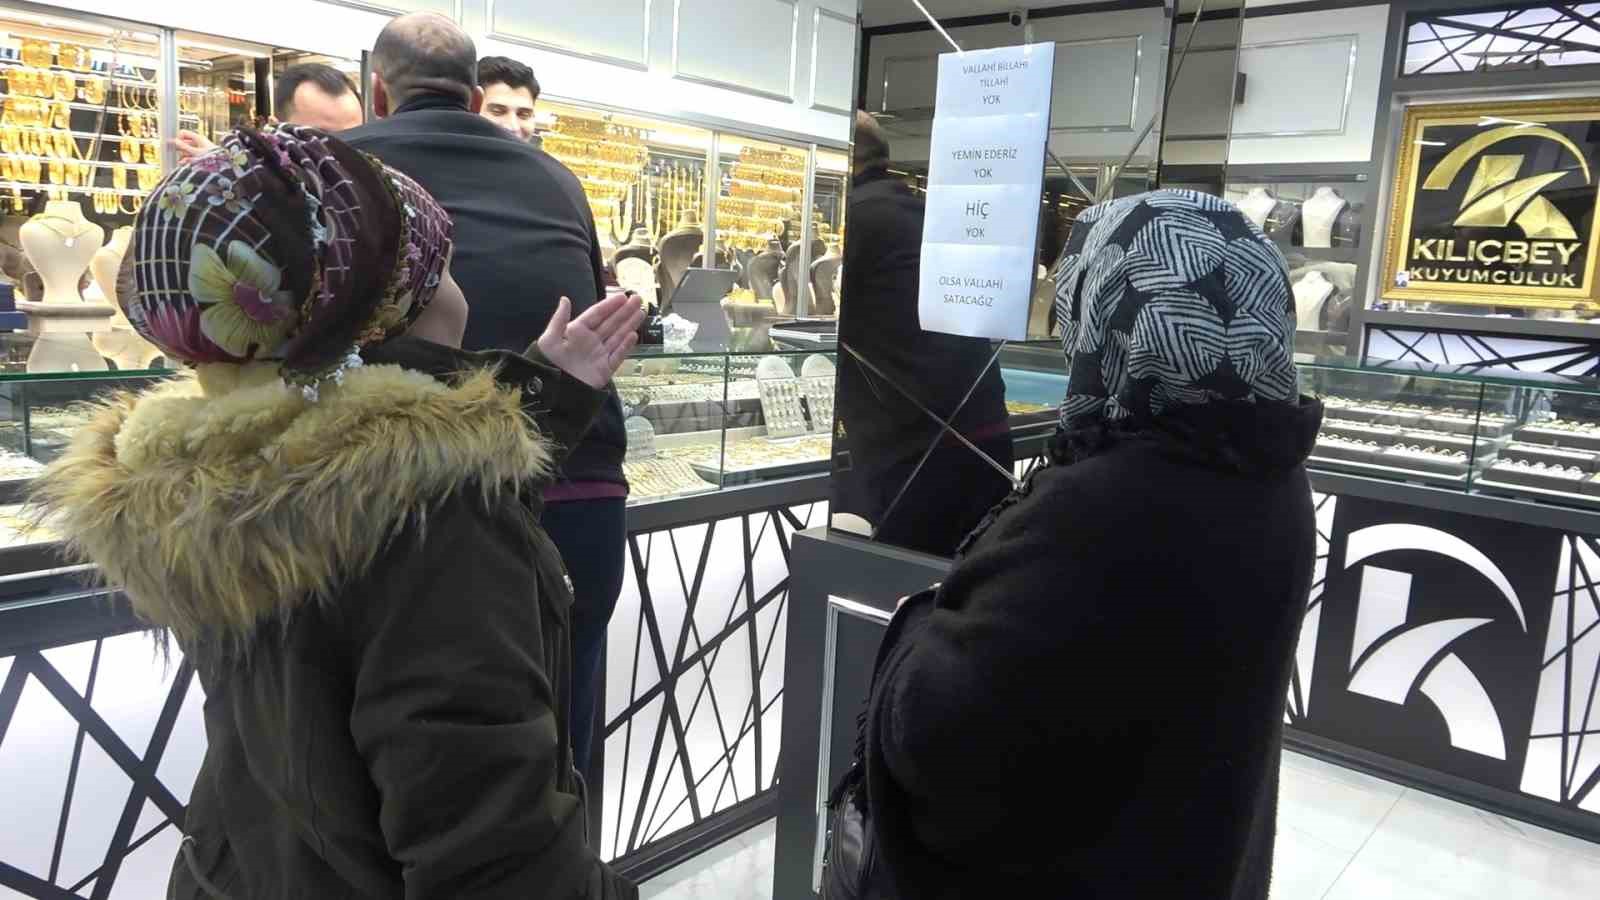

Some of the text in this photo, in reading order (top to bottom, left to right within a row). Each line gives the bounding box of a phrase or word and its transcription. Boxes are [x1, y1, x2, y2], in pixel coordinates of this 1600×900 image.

[983, 95, 1000, 104] YOK
[952, 147, 1017, 161] YEMİN EDERİZ
[975, 168, 993, 178] YOK
[965, 200, 990, 219] HİÇ
[966, 228, 984, 238] YOK
[1412, 238, 1582, 266] KILIÇBEY
[939, 276, 961, 287] OLSA
[1410, 267, 1577, 287] KUYUMCULUK
[944, 294, 993, 307] SATACAĞIZ
